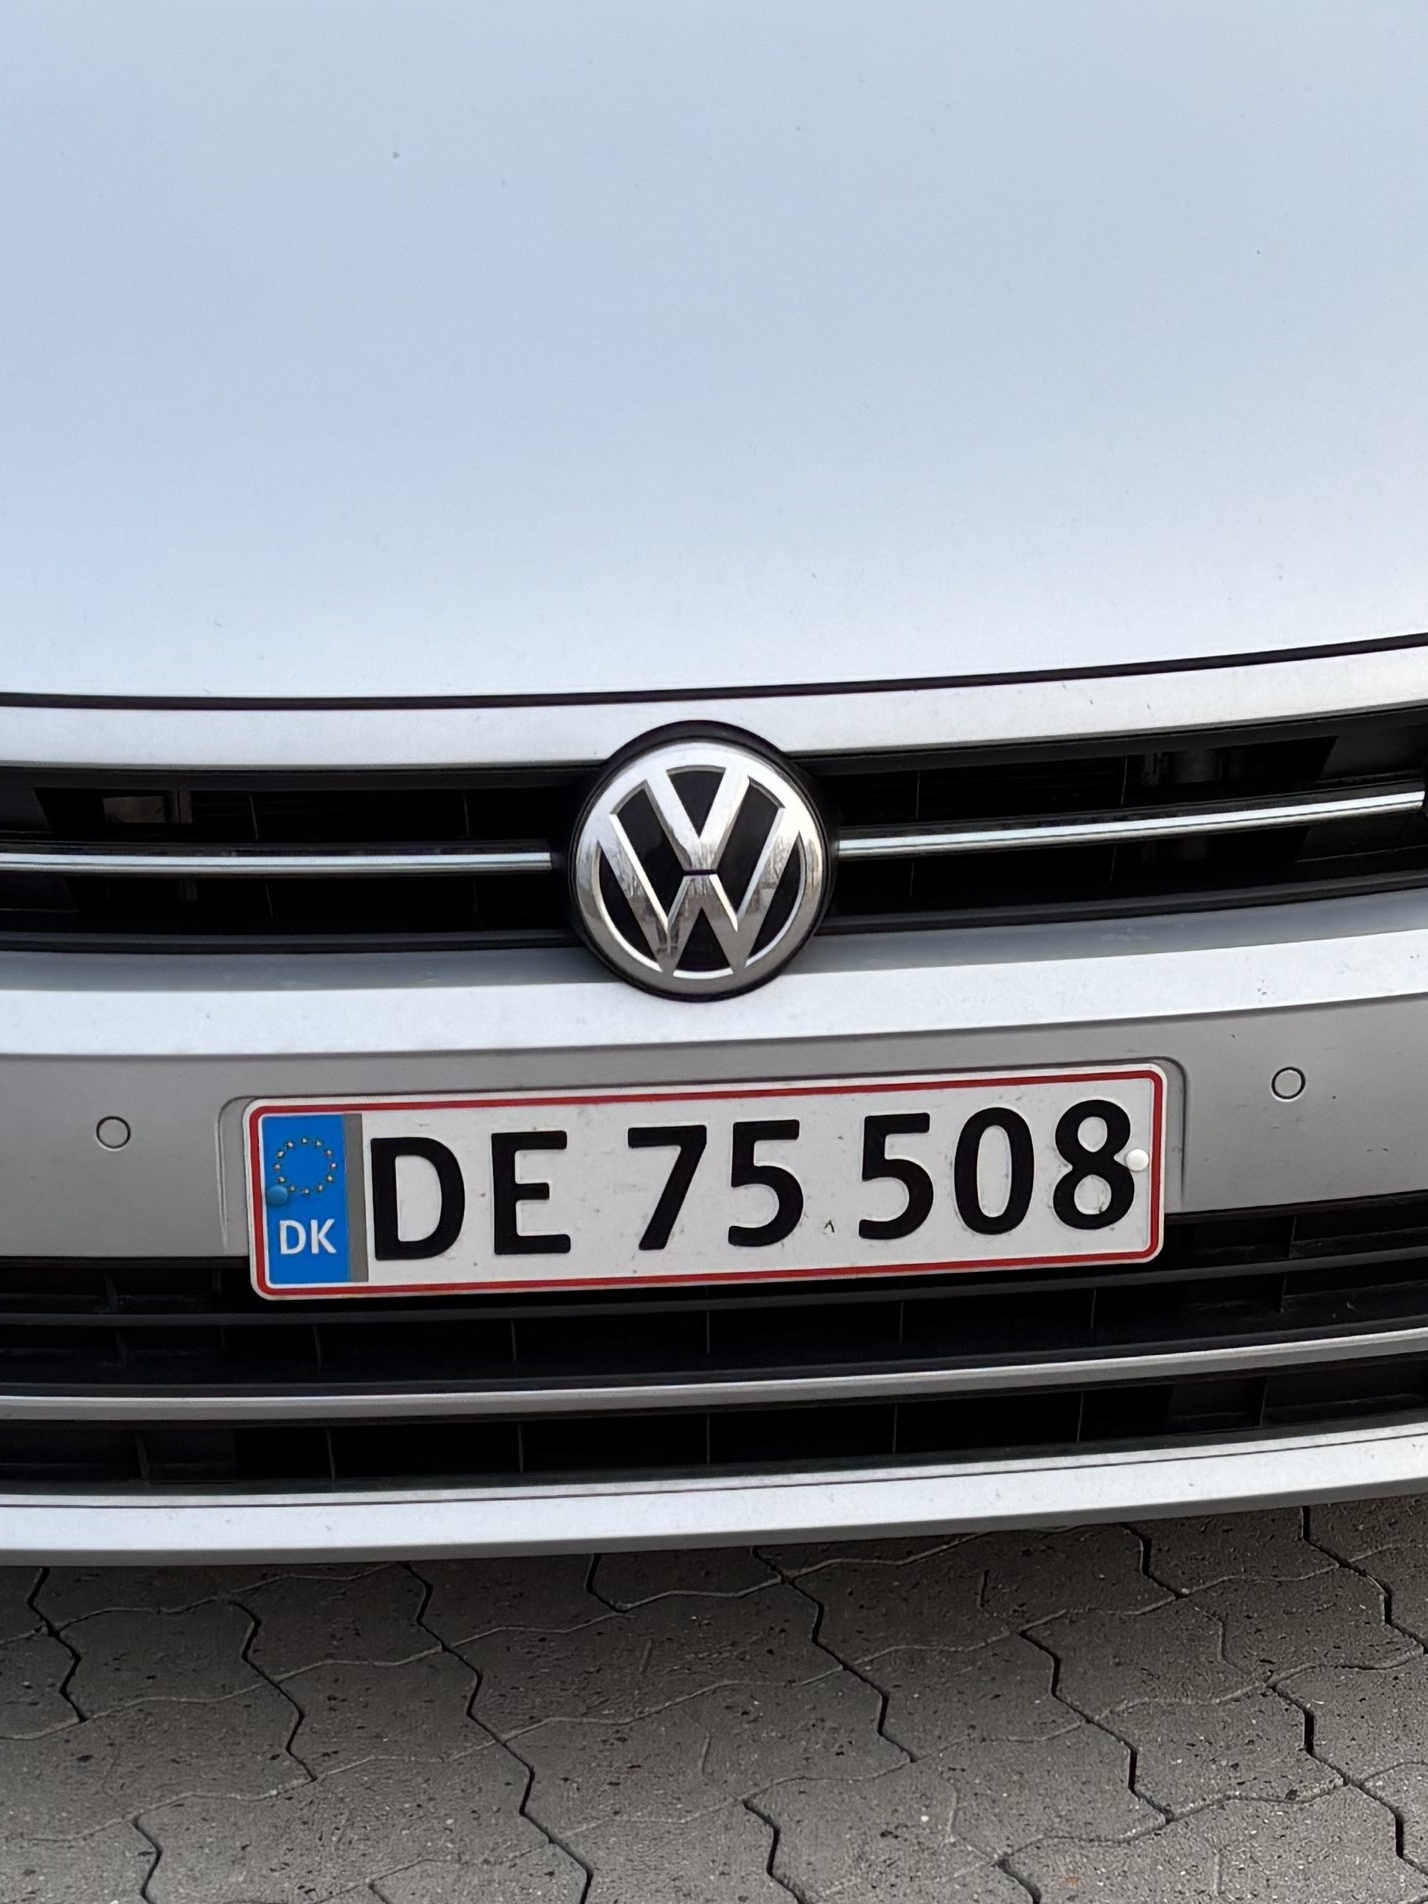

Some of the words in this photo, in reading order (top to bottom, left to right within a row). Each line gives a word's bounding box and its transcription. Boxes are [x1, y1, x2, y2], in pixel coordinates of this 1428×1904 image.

[575, 741, 824, 995] VW
[278, 1218, 338, 1257] DK
[369, 1129, 572, 1262] DE
[626, 1118, 801, 1252] 75
[856, 1099, 1135, 1242] 508
